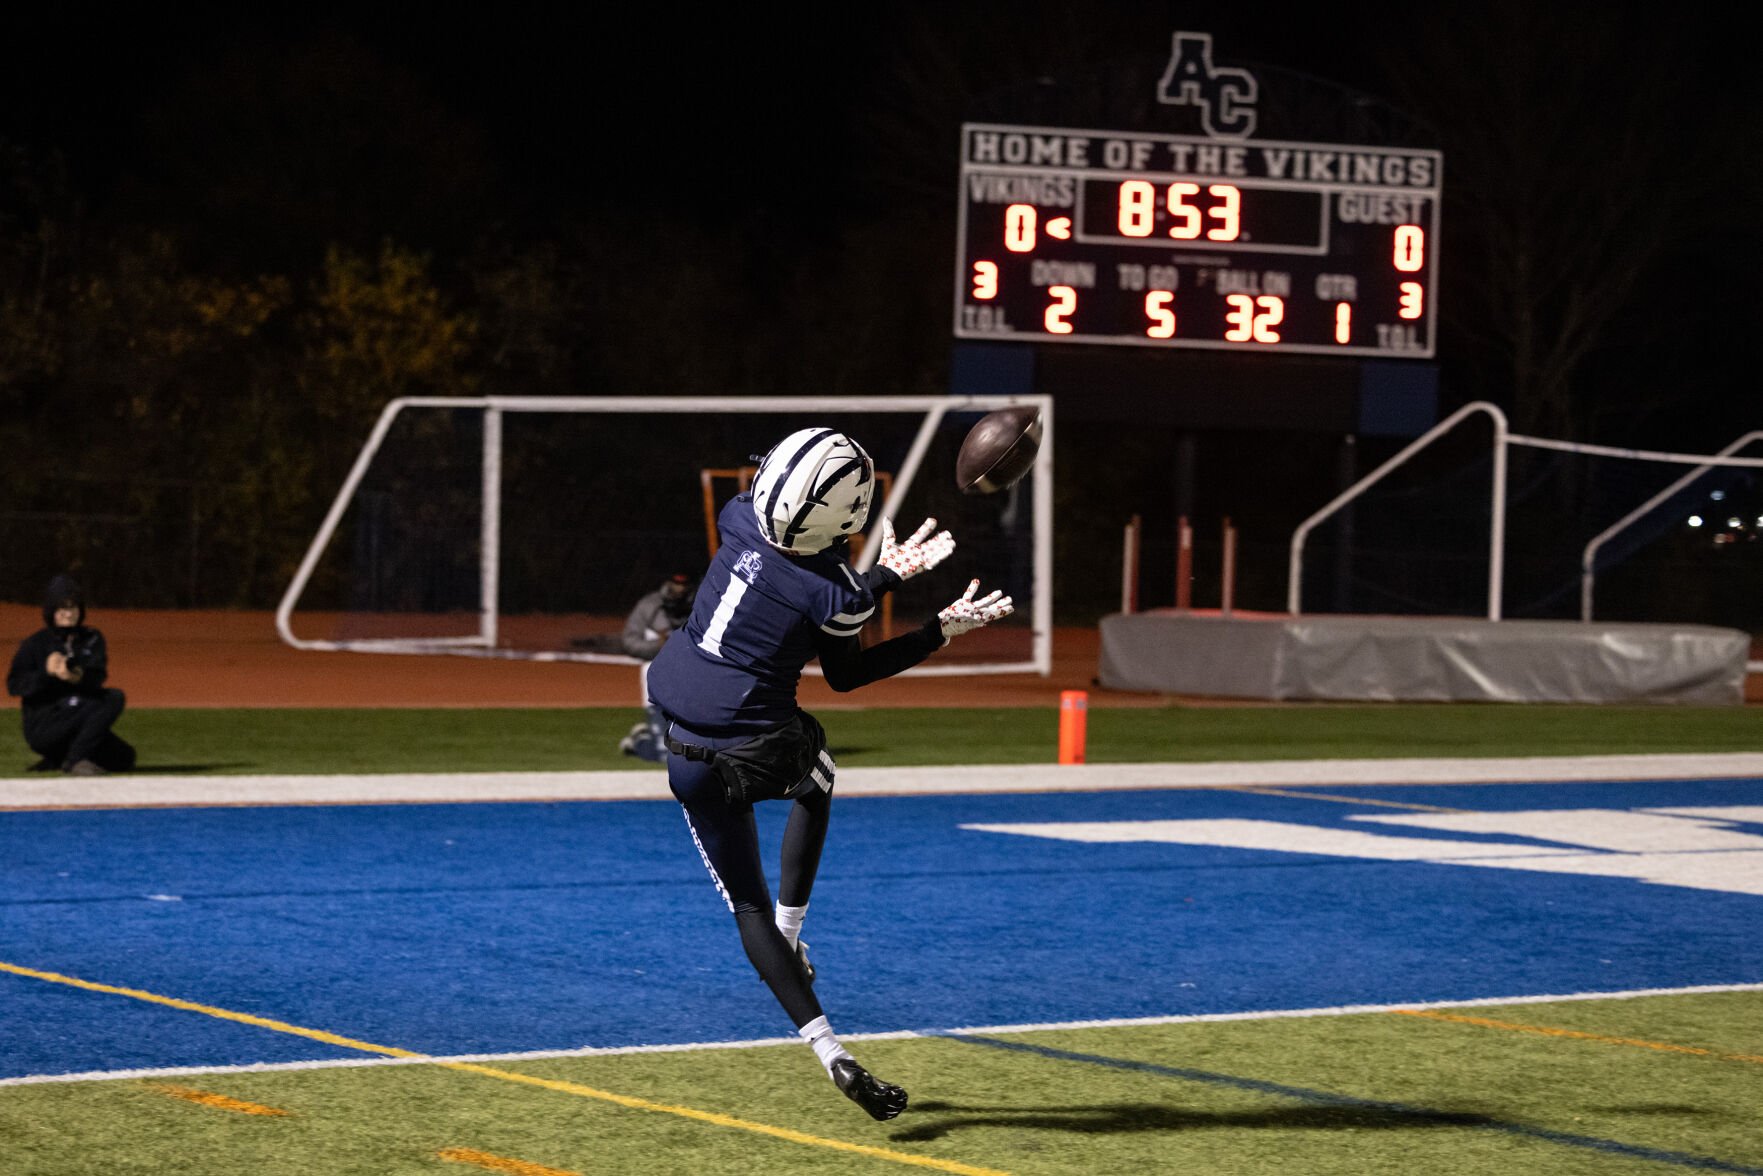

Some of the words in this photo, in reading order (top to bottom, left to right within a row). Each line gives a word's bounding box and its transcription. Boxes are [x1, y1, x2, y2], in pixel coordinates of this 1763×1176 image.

[1157, 31, 1258, 141] AC
[973, 132, 1090, 167] HOME
[1103, 139, 1154, 170] OF
[1169, 143, 1248, 176] THE
[1262, 149, 1432, 186] VIKINGS
[970, 174, 1074, 207] VIKINGS
[1118, 179, 1241, 242] 8:53
[1338, 191, 1424, 225] GUEST
[1004, 203, 1037, 252] 0
[1393, 225, 1424, 272] 0
[972, 260, 998, 299] 3
[1031, 259, 1096, 288] DOWN
[1117, 263, 1145, 290] TO
[1148, 264, 1179, 291] GO
[1216, 268, 1261, 295] BALL
[1262, 270, 1291, 298] ON
[1315, 273, 1357, 301] QTR
[1044, 285, 1077, 334] 2
[1145, 289, 1176, 339] 5
[1225, 294, 1284, 343] 32
[1399, 281, 1423, 319] 3
[1336, 302, 1351, 344] 1
[697, 572, 748, 659] 1
